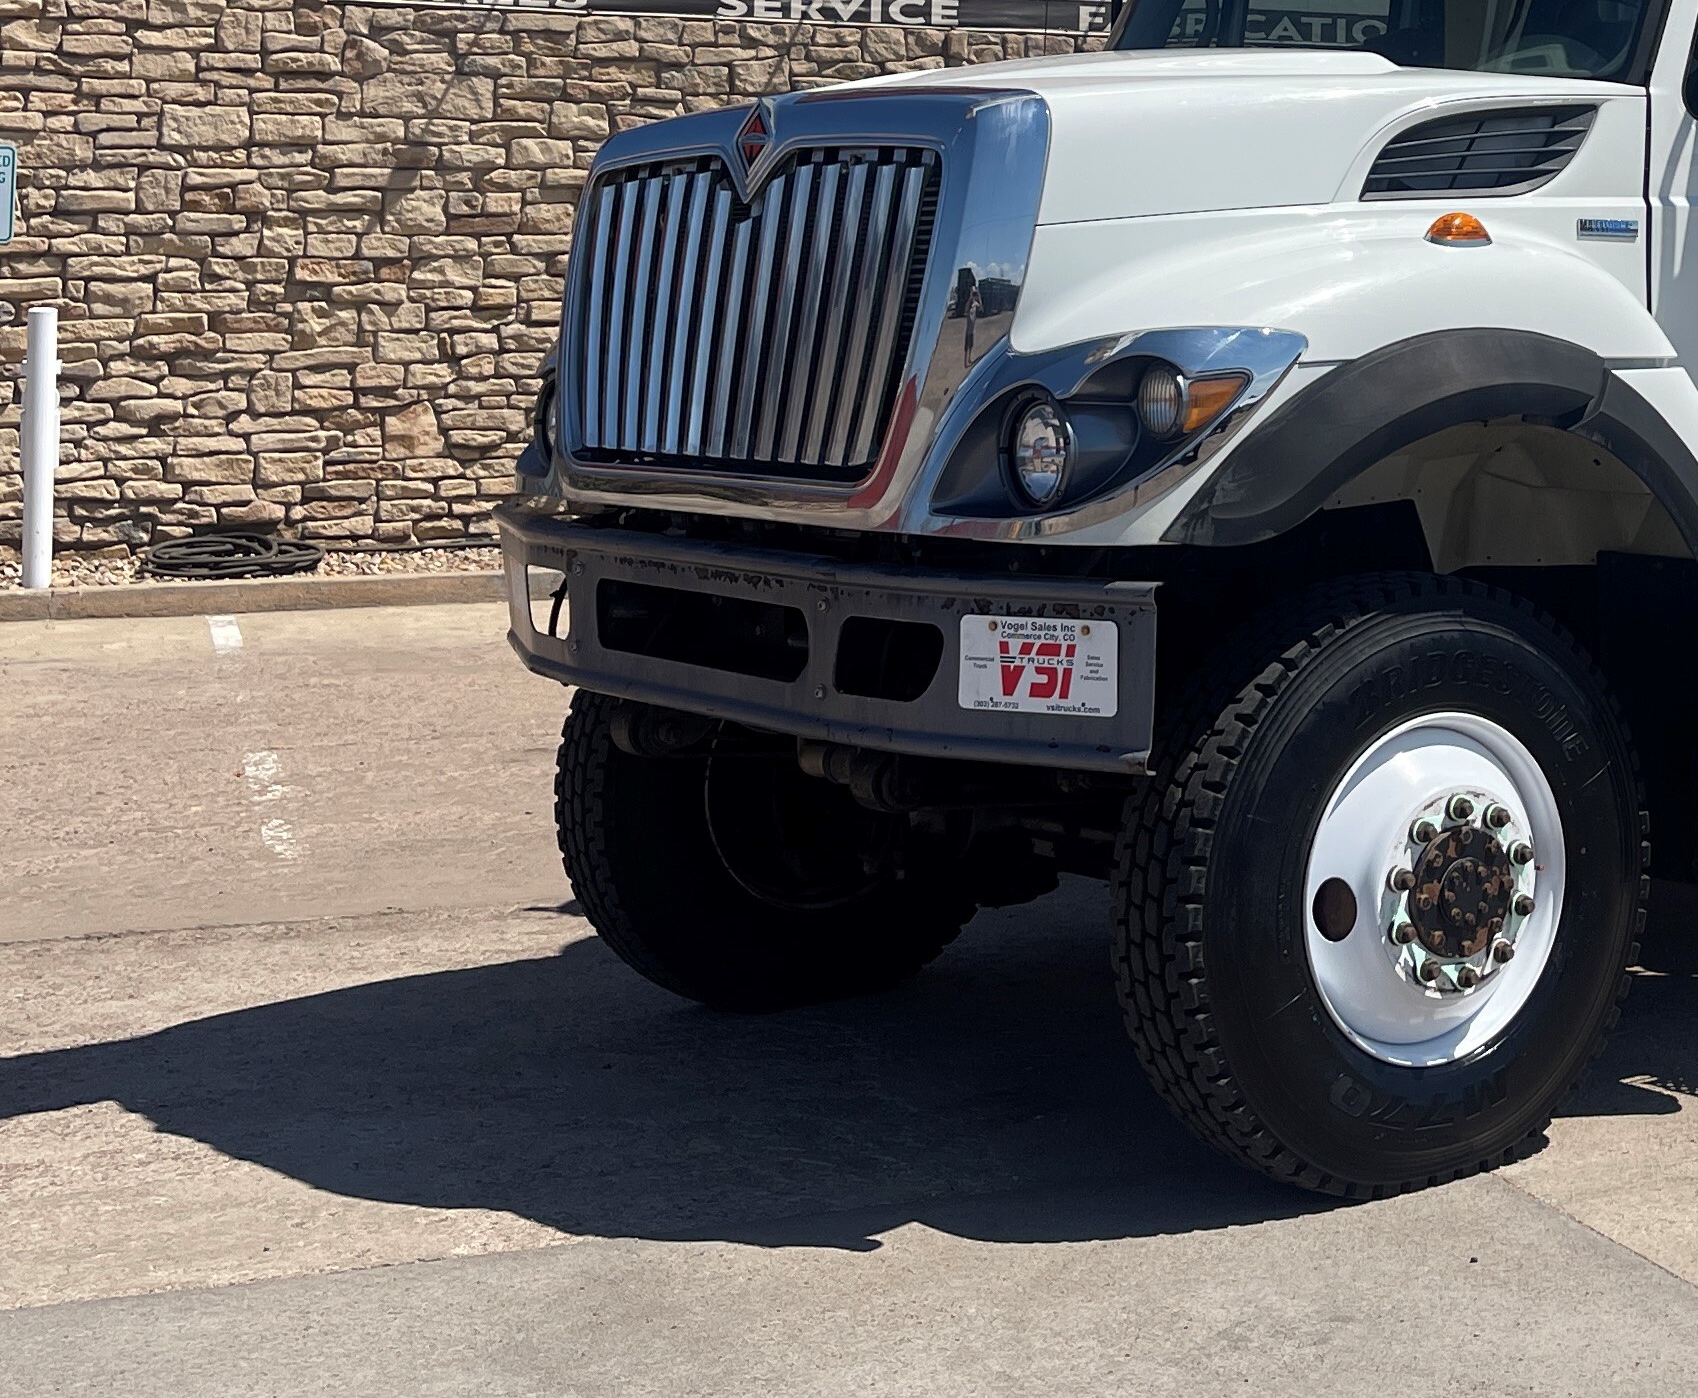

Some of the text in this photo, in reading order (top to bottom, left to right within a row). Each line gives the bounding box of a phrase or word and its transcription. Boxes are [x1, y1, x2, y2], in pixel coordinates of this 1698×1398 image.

[1000, 620, 1076, 633] Vogel Sales Inc
[1001, 630, 1042, 640] Commerce
[1063, 633, 1076, 642] CO
[1018, 656, 1075, 666] TRUCKS
[998, 640, 1077, 700] VSI
